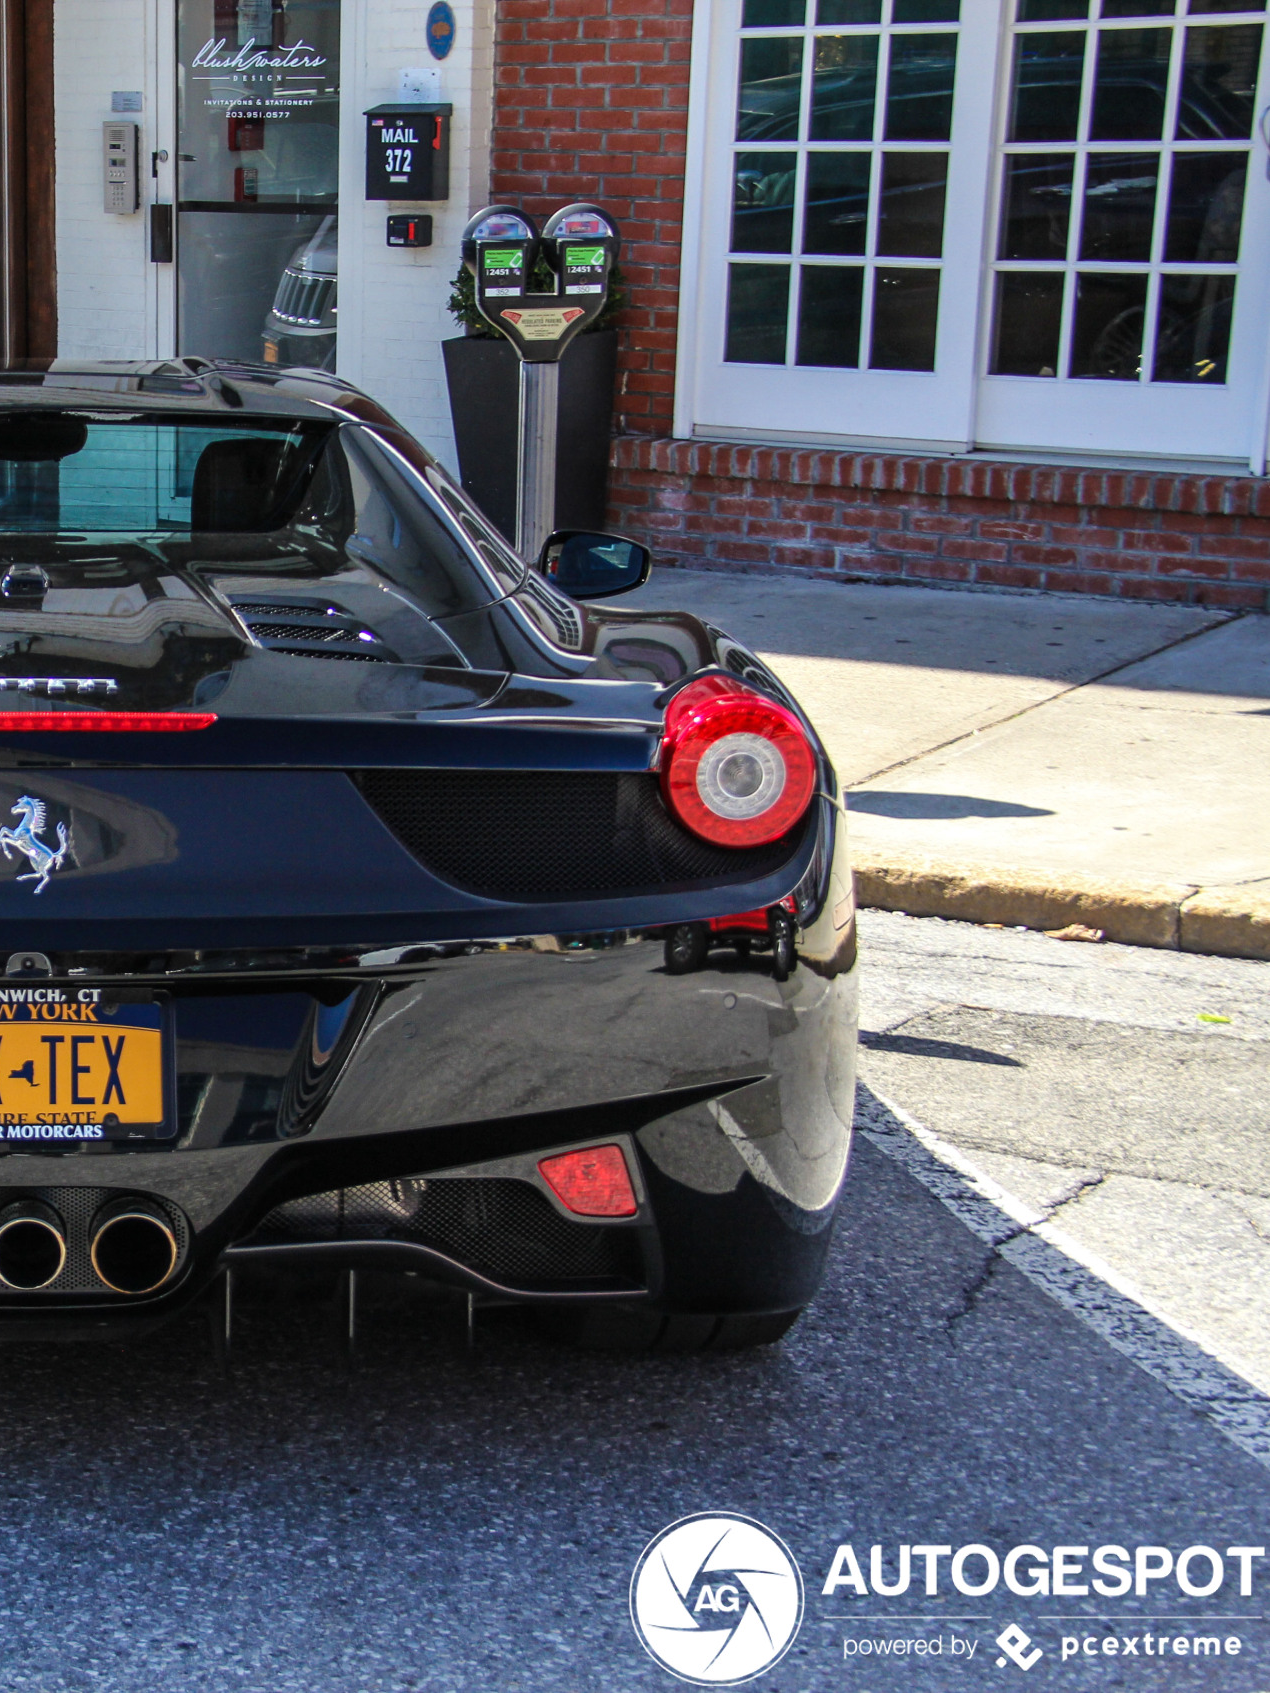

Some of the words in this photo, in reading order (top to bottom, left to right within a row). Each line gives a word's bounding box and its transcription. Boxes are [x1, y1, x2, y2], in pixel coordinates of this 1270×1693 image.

[225, 111, 291, 119] 203.951.0577
[381, 128, 419, 143] MAIL
[385, 149, 412, 172] 372
[489, 268, 509, 276] 2451
[78, 989, 101, 1003] CT
[27, 1003, 99, 1022] YORK
[41, 1035, 126, 1105] TEX
[36, 1111, 97, 1125] STATE
[6, 1124, 103, 1139] MOTORCARS
